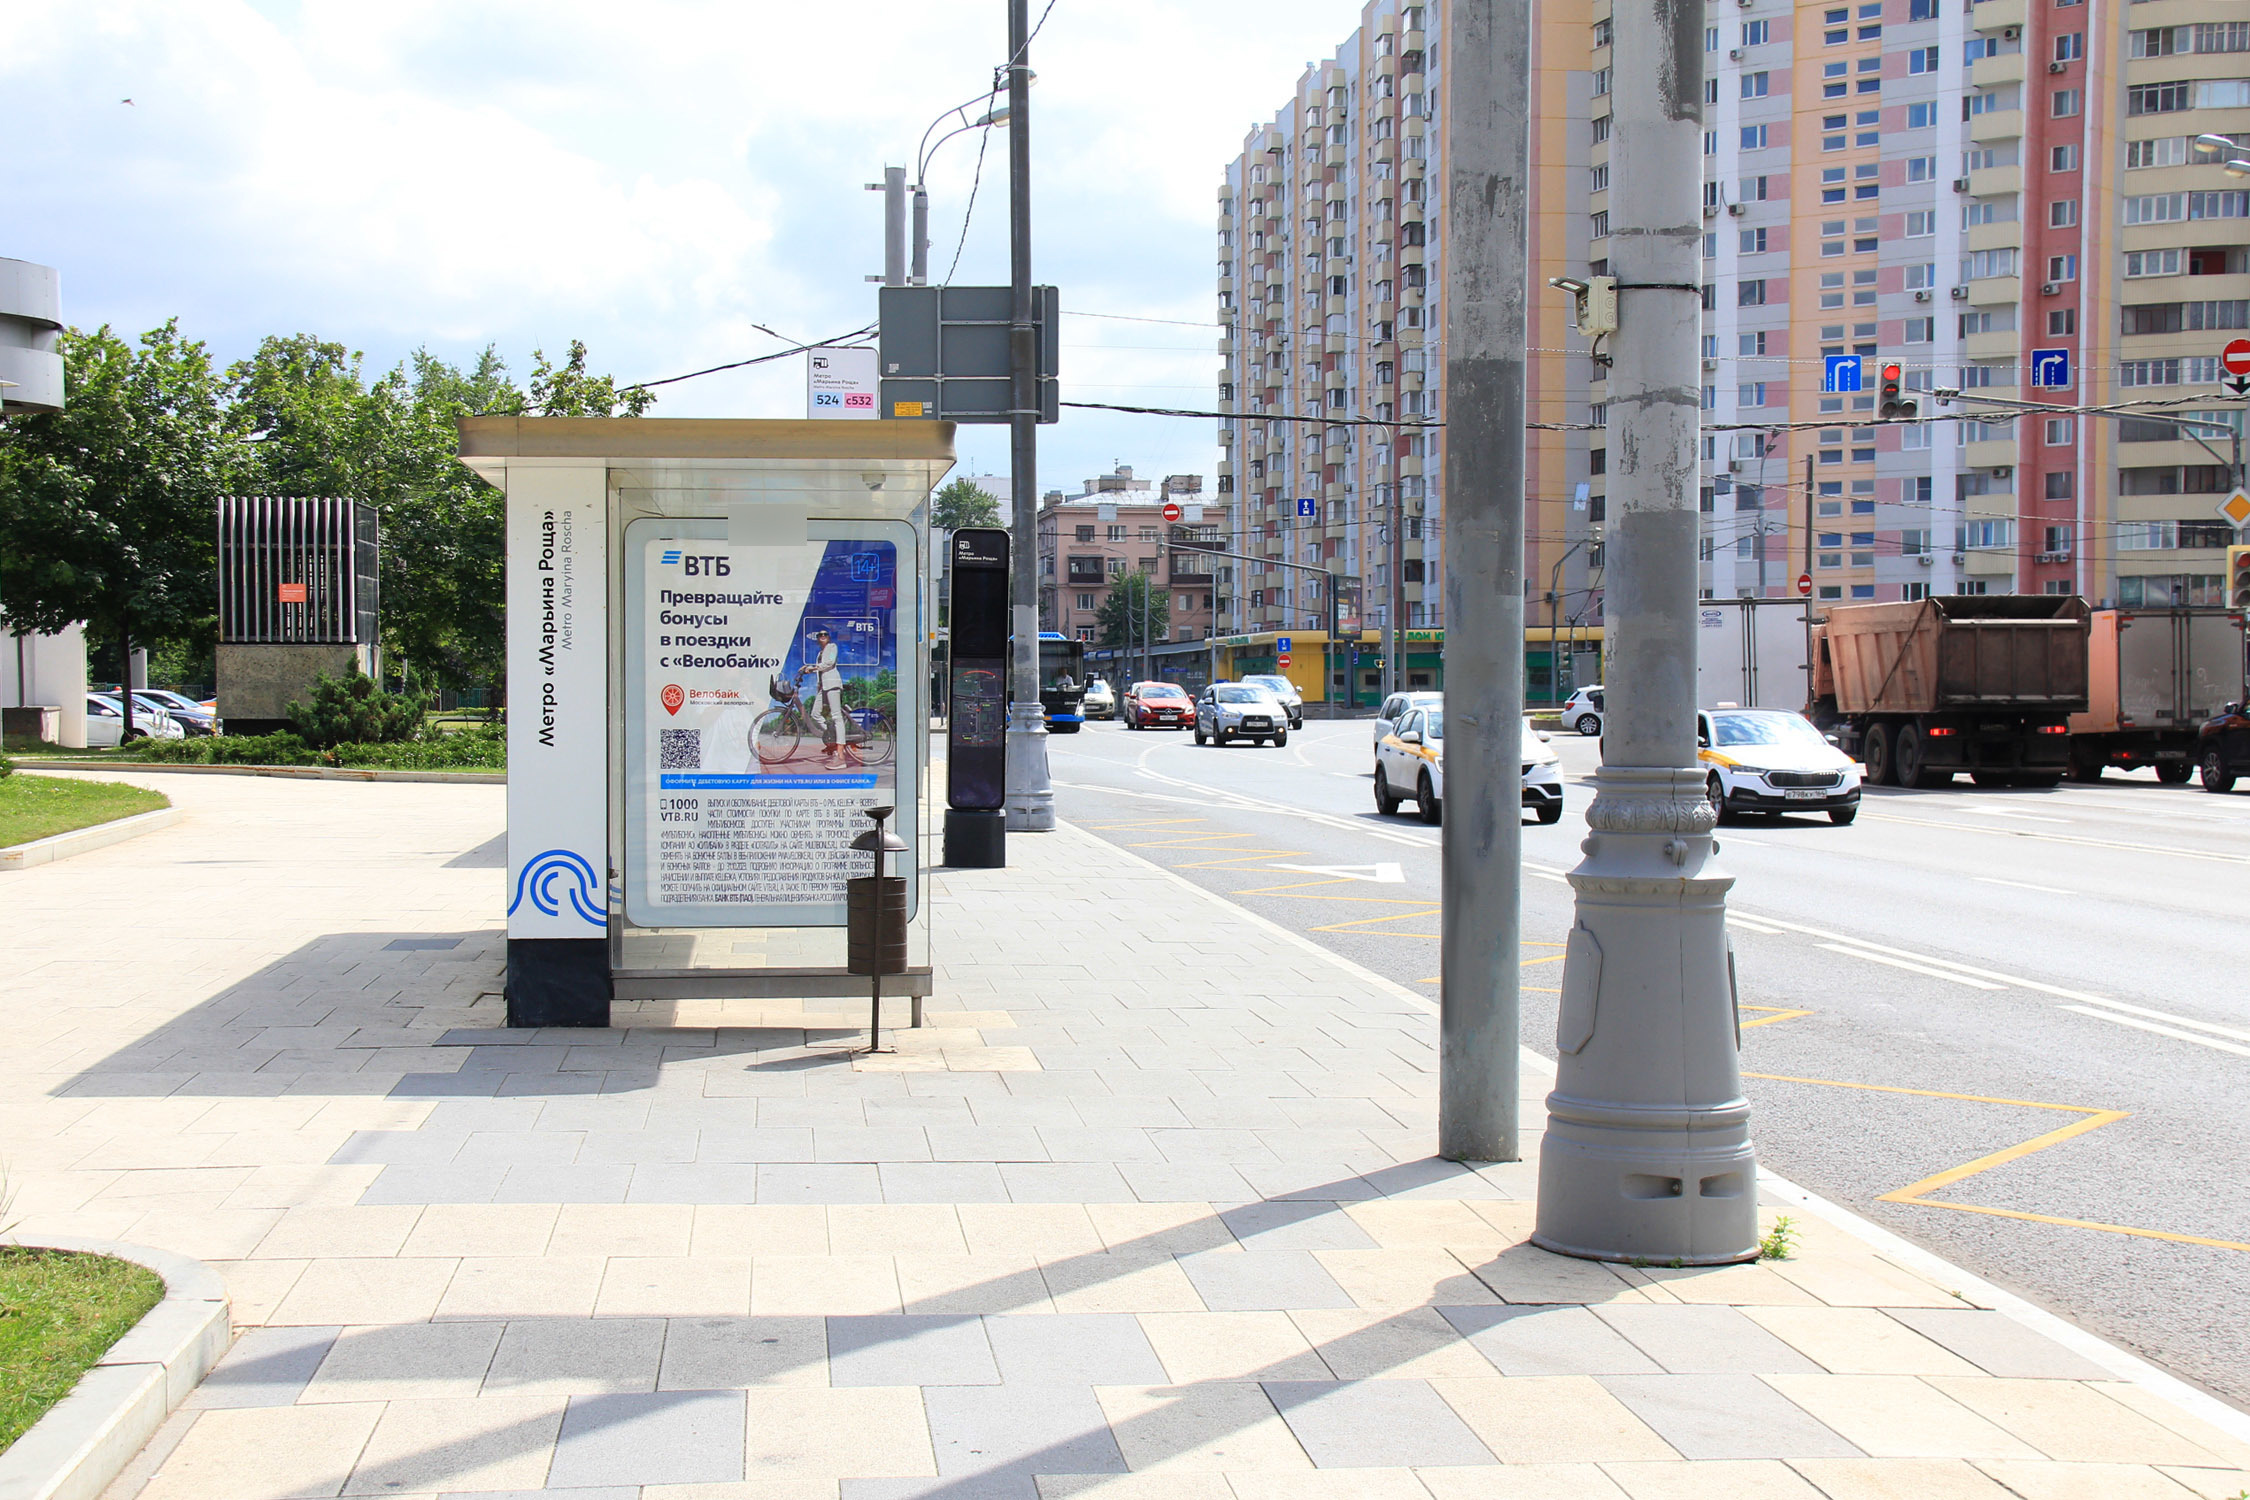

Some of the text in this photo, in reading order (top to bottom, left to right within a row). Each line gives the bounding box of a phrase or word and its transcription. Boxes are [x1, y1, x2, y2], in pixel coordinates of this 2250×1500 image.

[816, 395, 839, 405] 524
[684, 556, 731, 576] ВТБ
[854, 560, 876, 576] 14+
[562, 510, 574, 650] Metro Maryina Roscha
[660, 590, 784, 607] Превращайте
[660, 611, 728, 628] бонусы
[538, 510, 558, 747] Метро «Марьина Роща»
[856, 622, 874, 632] ВТБ
[660, 636, 751, 649] в поездки
[1394, 632, 1432, 641] СЛОН
[660, 654, 780, 668] с «Велобайк»
[690, 689, 739, 698] Велобайк
[670, 799, 698, 809] 1000
[661, 812, 698, 822] VTB.RU
